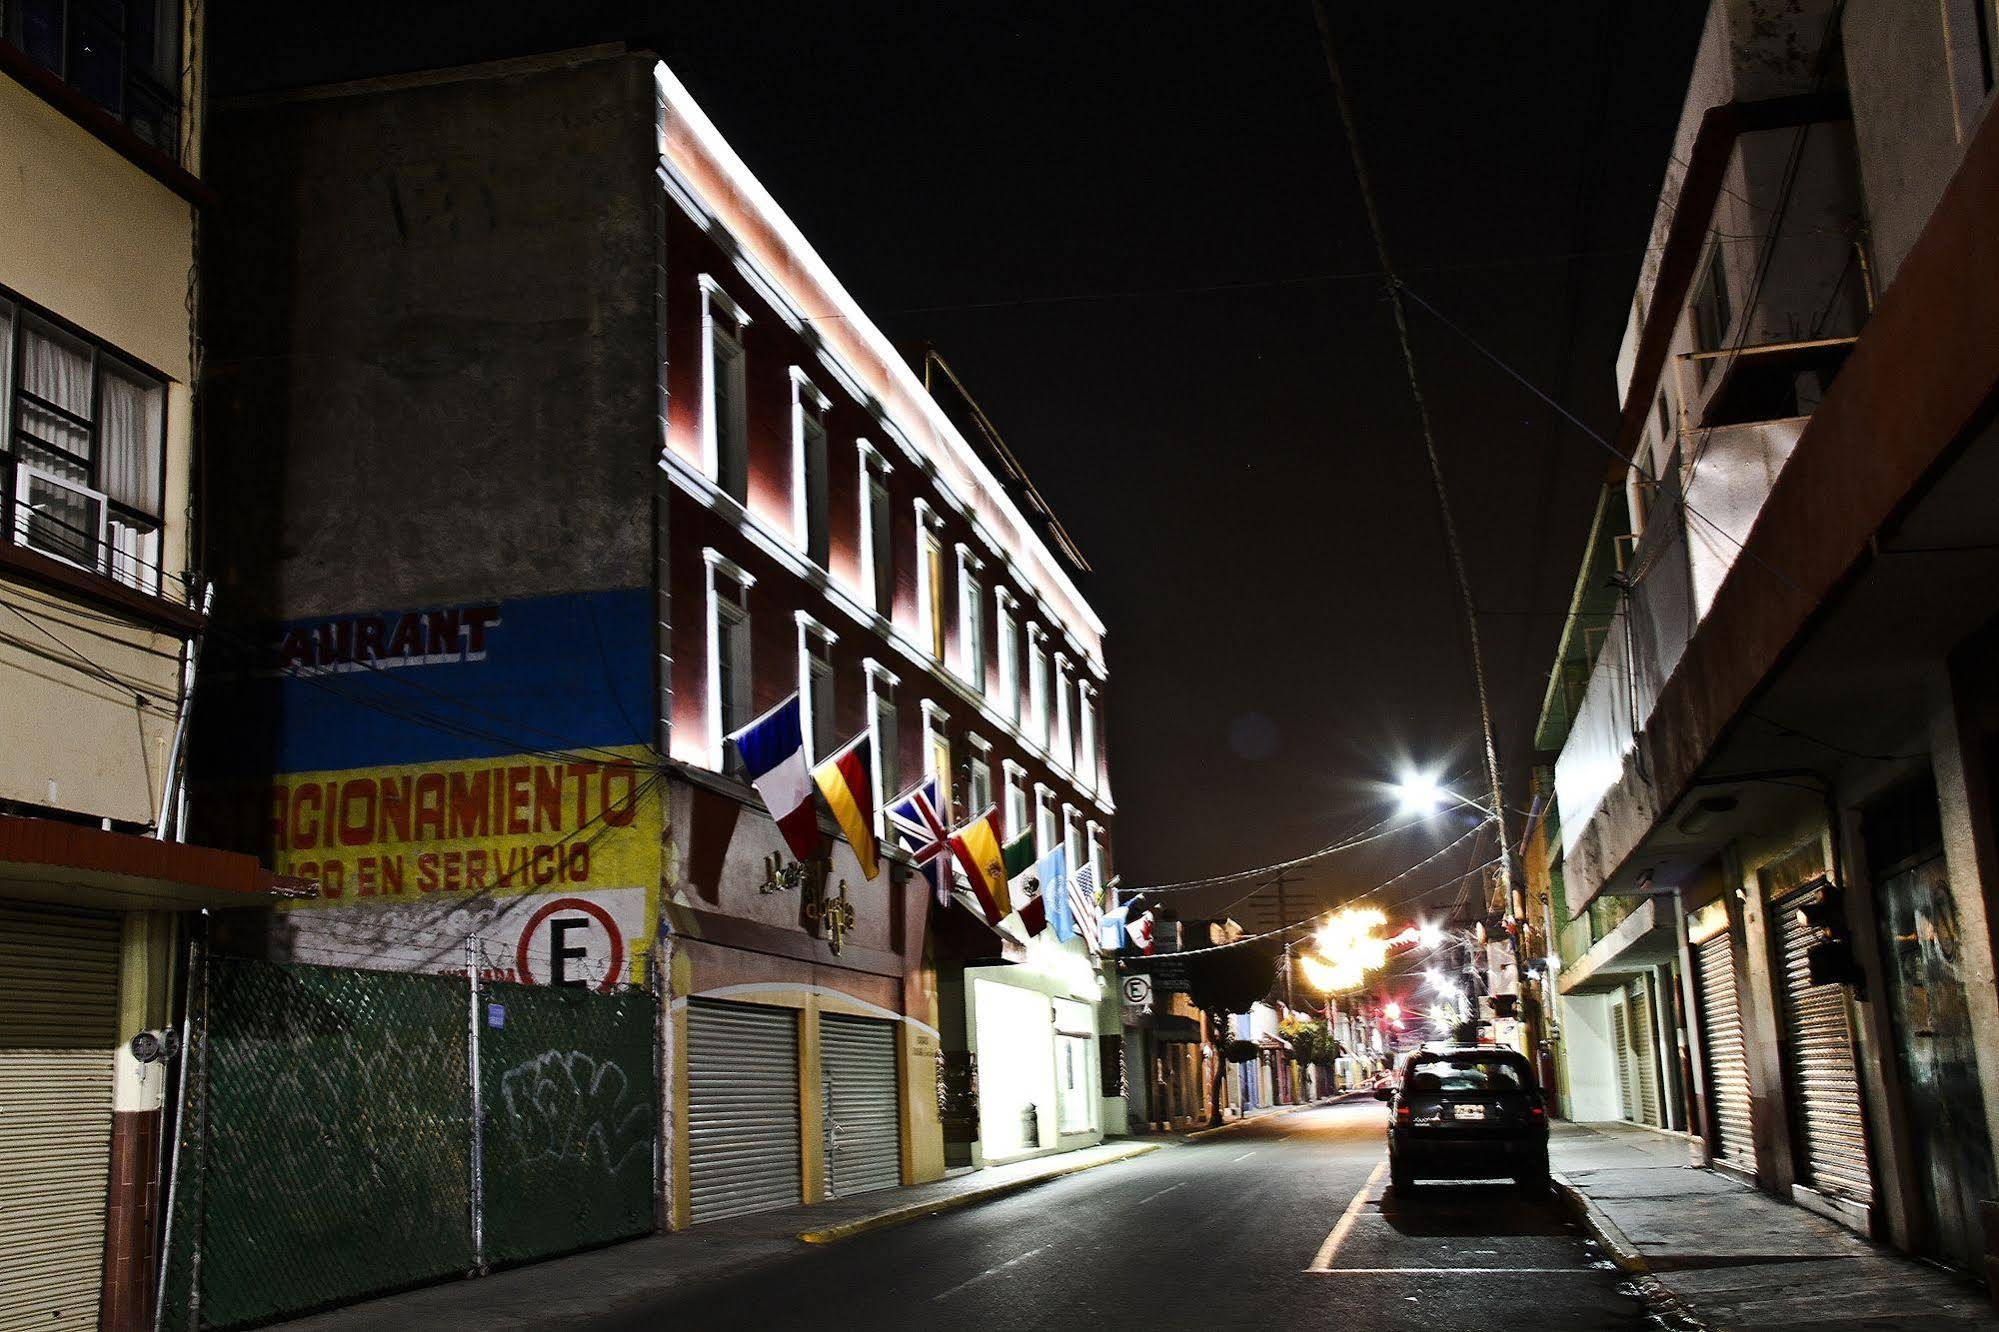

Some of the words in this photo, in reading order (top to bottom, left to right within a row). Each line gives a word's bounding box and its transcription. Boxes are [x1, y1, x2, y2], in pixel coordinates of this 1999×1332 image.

[357, 855, 404, 897] EN
[416, 842, 590, 893] SERVICIO
[551, 918, 589, 987] E
